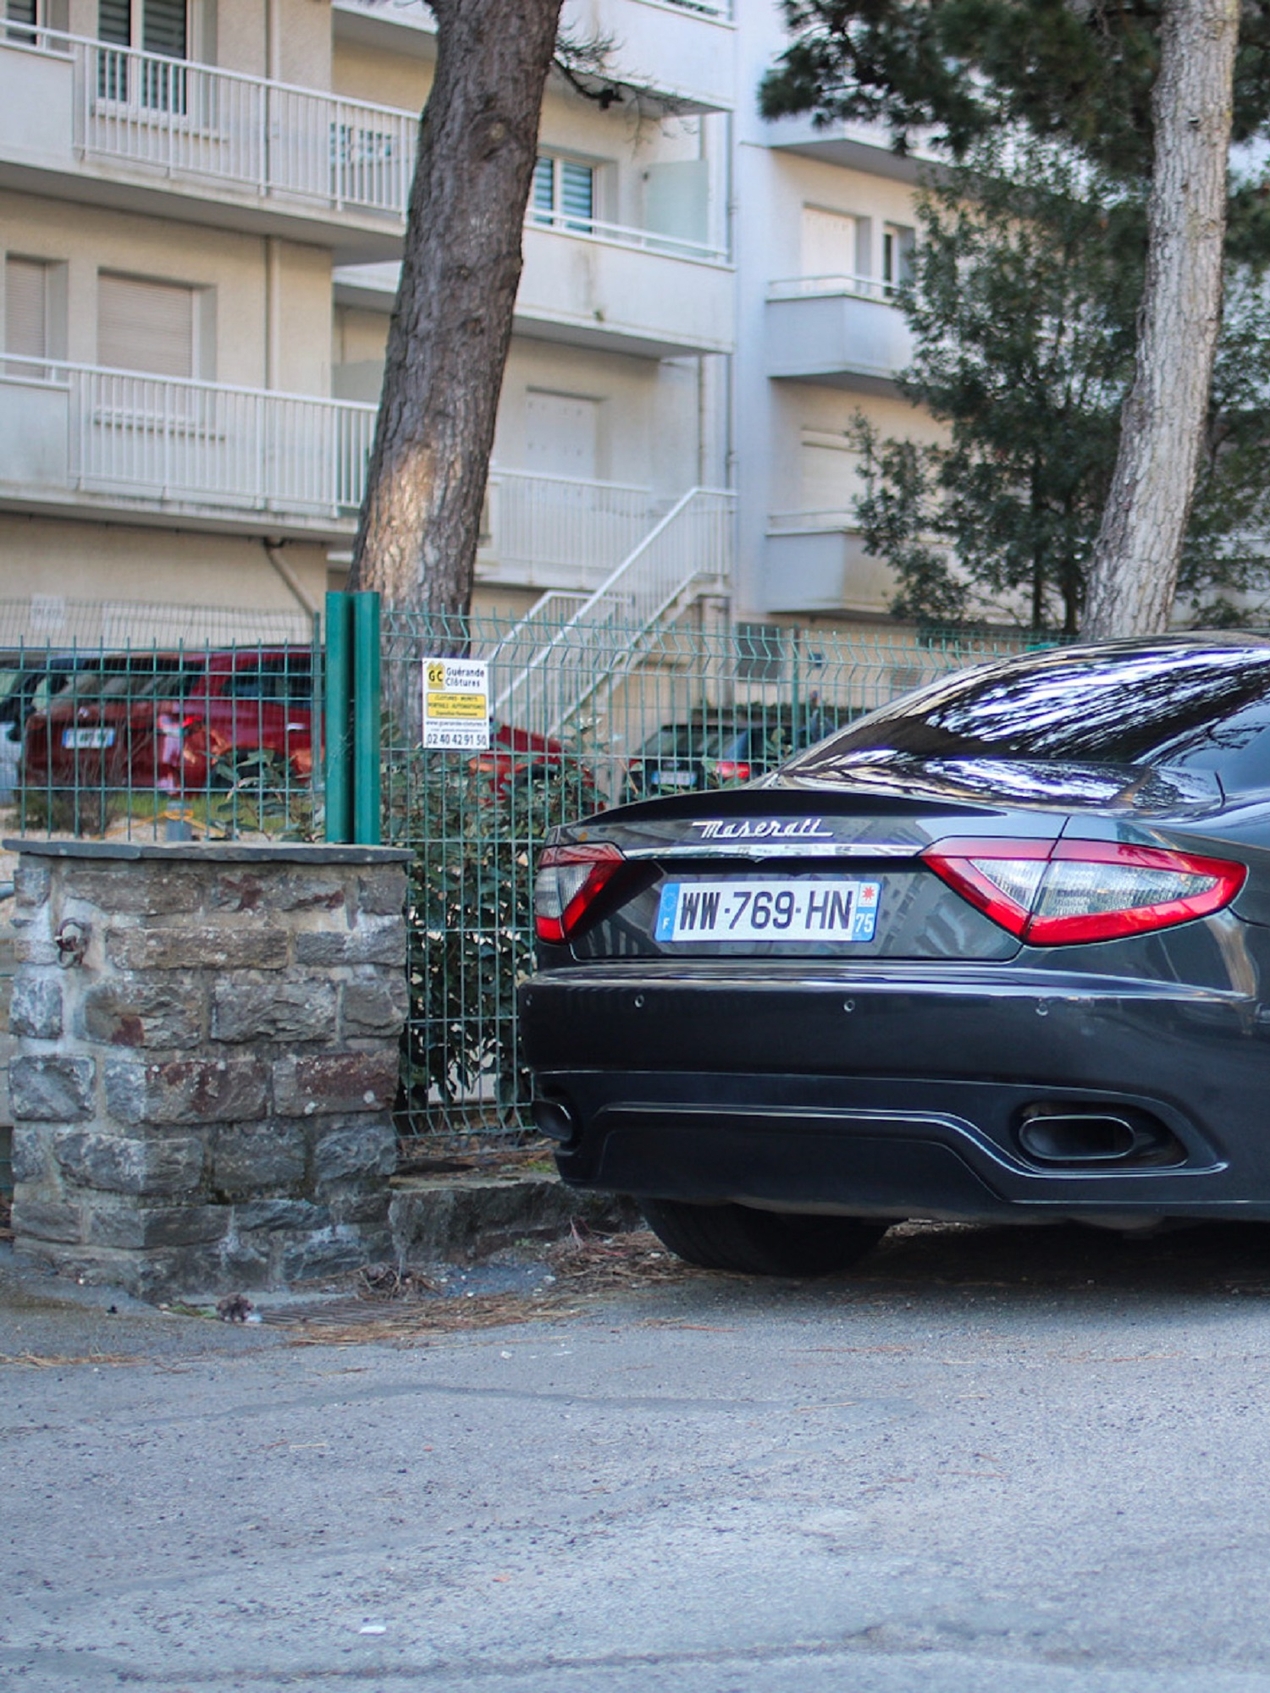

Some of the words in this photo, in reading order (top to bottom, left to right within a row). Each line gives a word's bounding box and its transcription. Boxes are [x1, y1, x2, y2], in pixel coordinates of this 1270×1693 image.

[428, 669, 443, 682] GC
[446, 667, 485, 678] Guérande
[445, 677, 480, 687] Clôtures
[427, 733, 438, 745] 02
[440, 733, 451, 745] 40
[452, 734, 463, 746] 42
[464, 734, 474, 746] 91
[476, 734, 487, 746] 50
[692, 819, 833, 838] Maserati
[662, 918, 669, 930] F
[855, 913, 874, 933] 75
